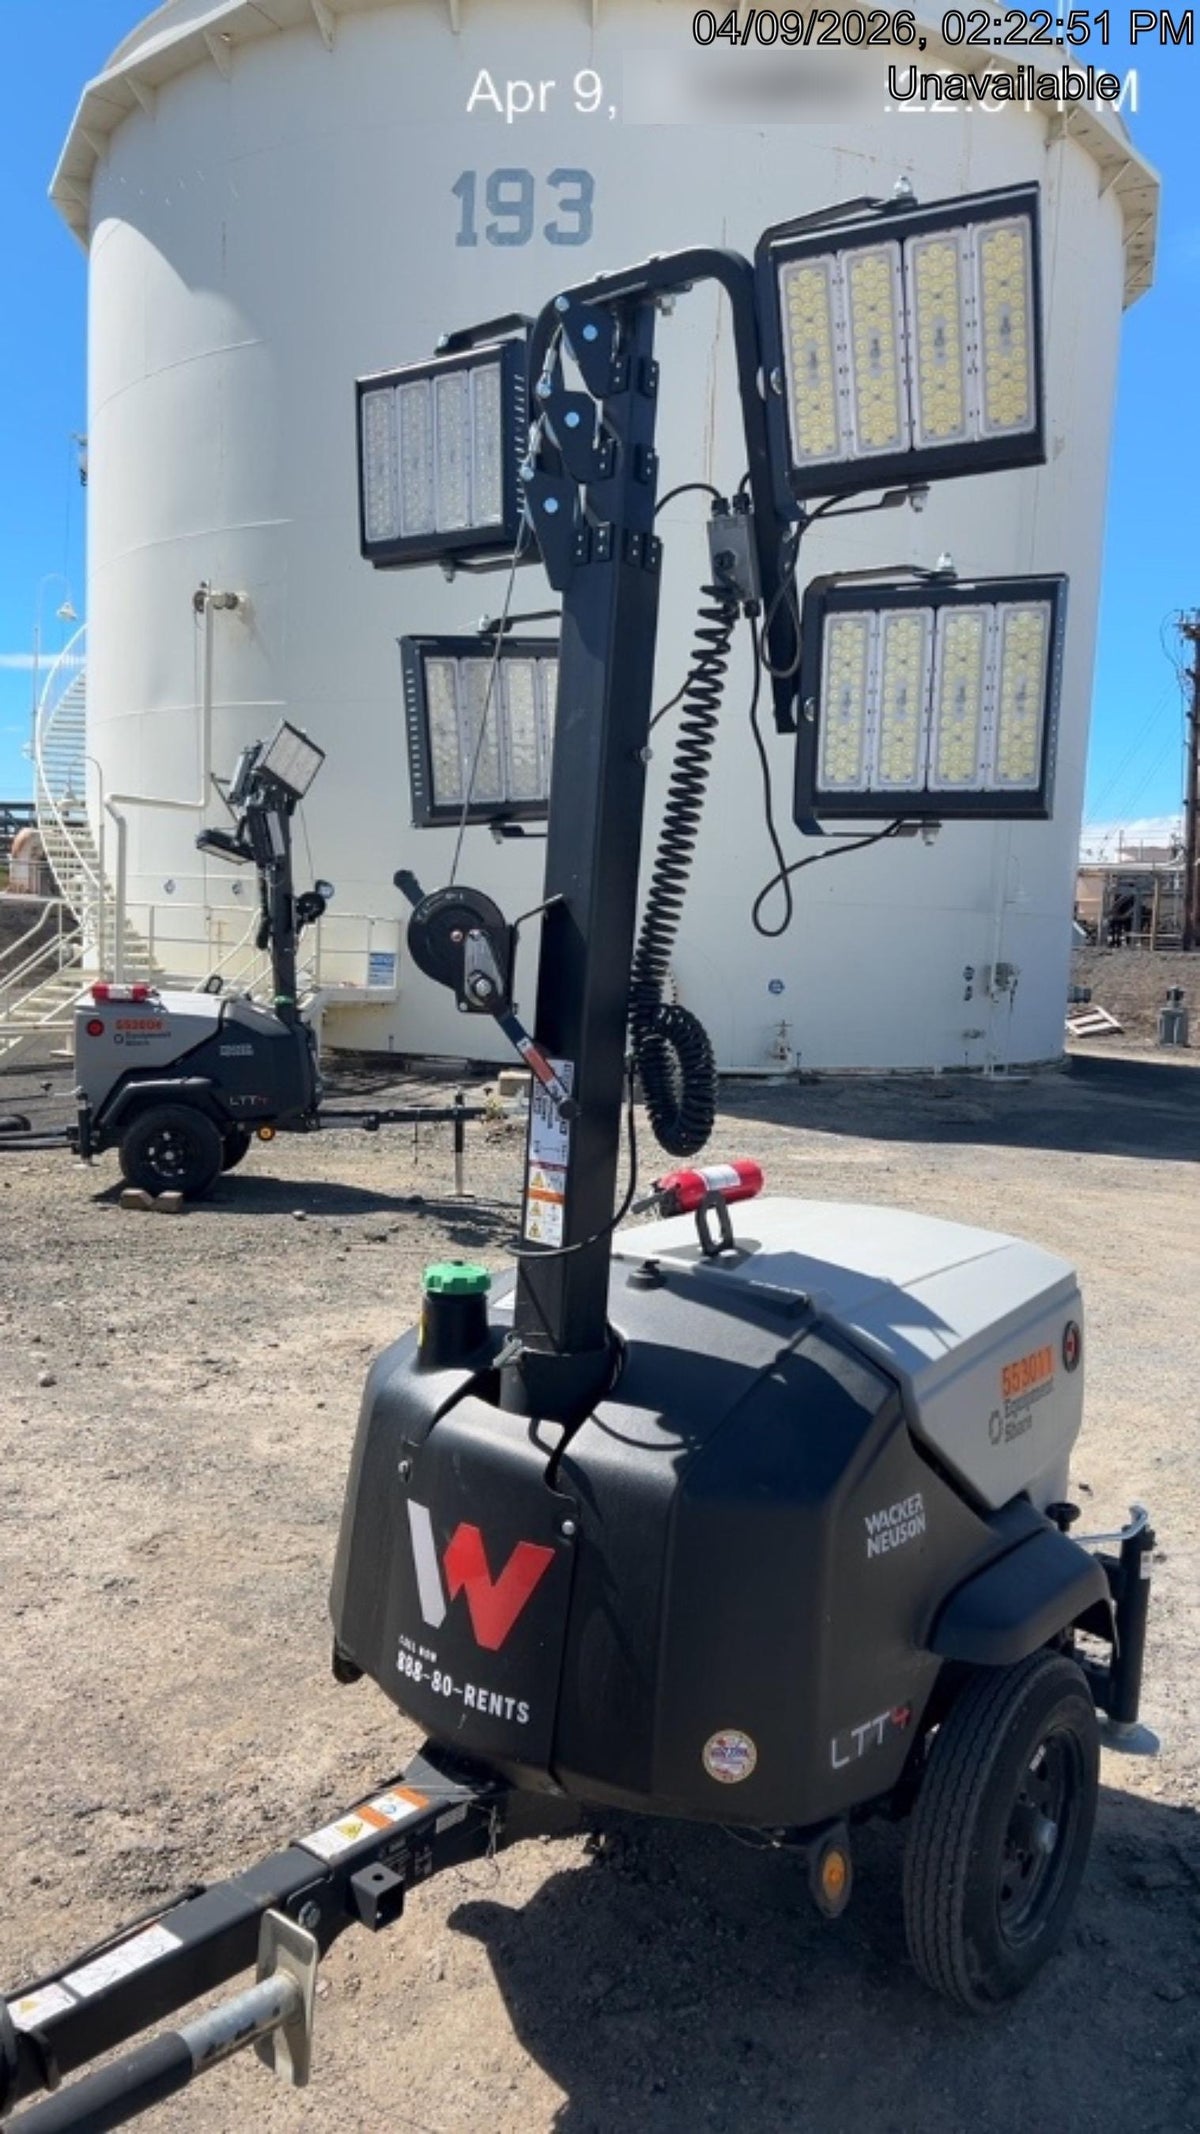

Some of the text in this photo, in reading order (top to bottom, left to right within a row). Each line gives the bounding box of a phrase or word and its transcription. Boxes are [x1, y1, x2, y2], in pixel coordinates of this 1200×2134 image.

[451, 167, 597, 247] 193
[864, 1493, 924, 1535] WACKER
[866, 1512, 926, 1559] NEUSON
[397, 1651, 530, 1724] 888-80-RENTS
